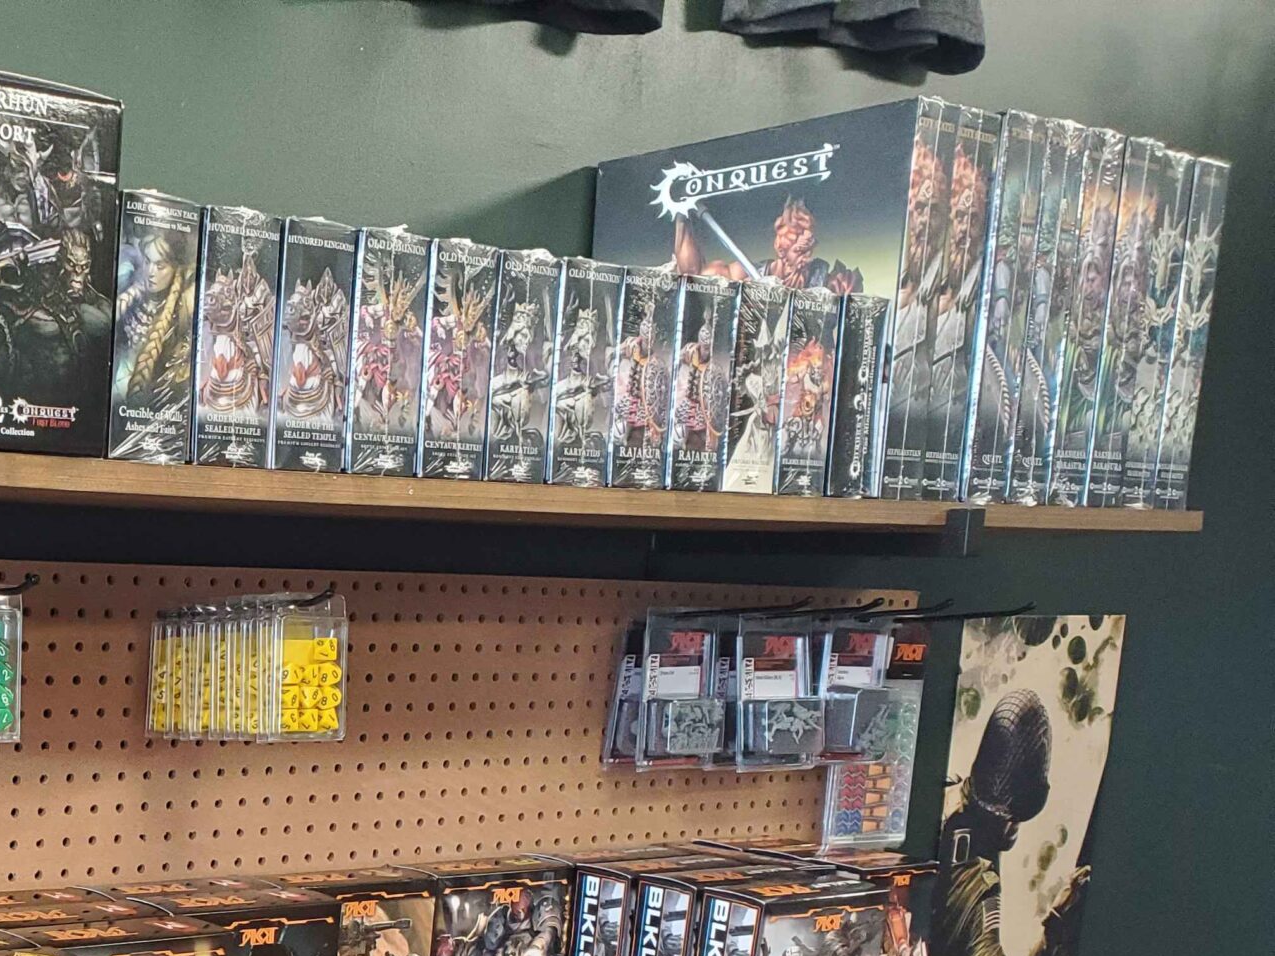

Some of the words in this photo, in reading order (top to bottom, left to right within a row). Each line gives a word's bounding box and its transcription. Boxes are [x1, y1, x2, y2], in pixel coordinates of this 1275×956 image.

[650, 144, 838, 220] CONQUEST
[126, 201, 147, 211] LORE
[208, 223, 244, 236] HUNDRED
[288, 235, 323, 248] HUNDRED
[367, 238, 384, 250] OLD
[439, 250, 457, 262] OLD
[505, 260, 522, 271] OLD
[569, 267, 584, 279] OLD
[586, 270, 621, 284] DOMINION
[8, 397, 77, 423] CONQUEST
[119, 406, 153, 420] Crucible
[205, 424, 232, 435] SEALED
[234, 426, 261, 437] TEMPLE
[285, 419, 309, 430] ORDER
[1, 427, 35, 437] Collection
[283, 430, 310, 440] SEALED
[311, 431, 337, 442] TEMPLE
[353, 432, 385, 443] CENTAUR
[425, 440, 457, 451] CENTAUR
[619, 446, 661, 460] RAJAKUR
[678, 450, 717, 463] RAJAKUR
